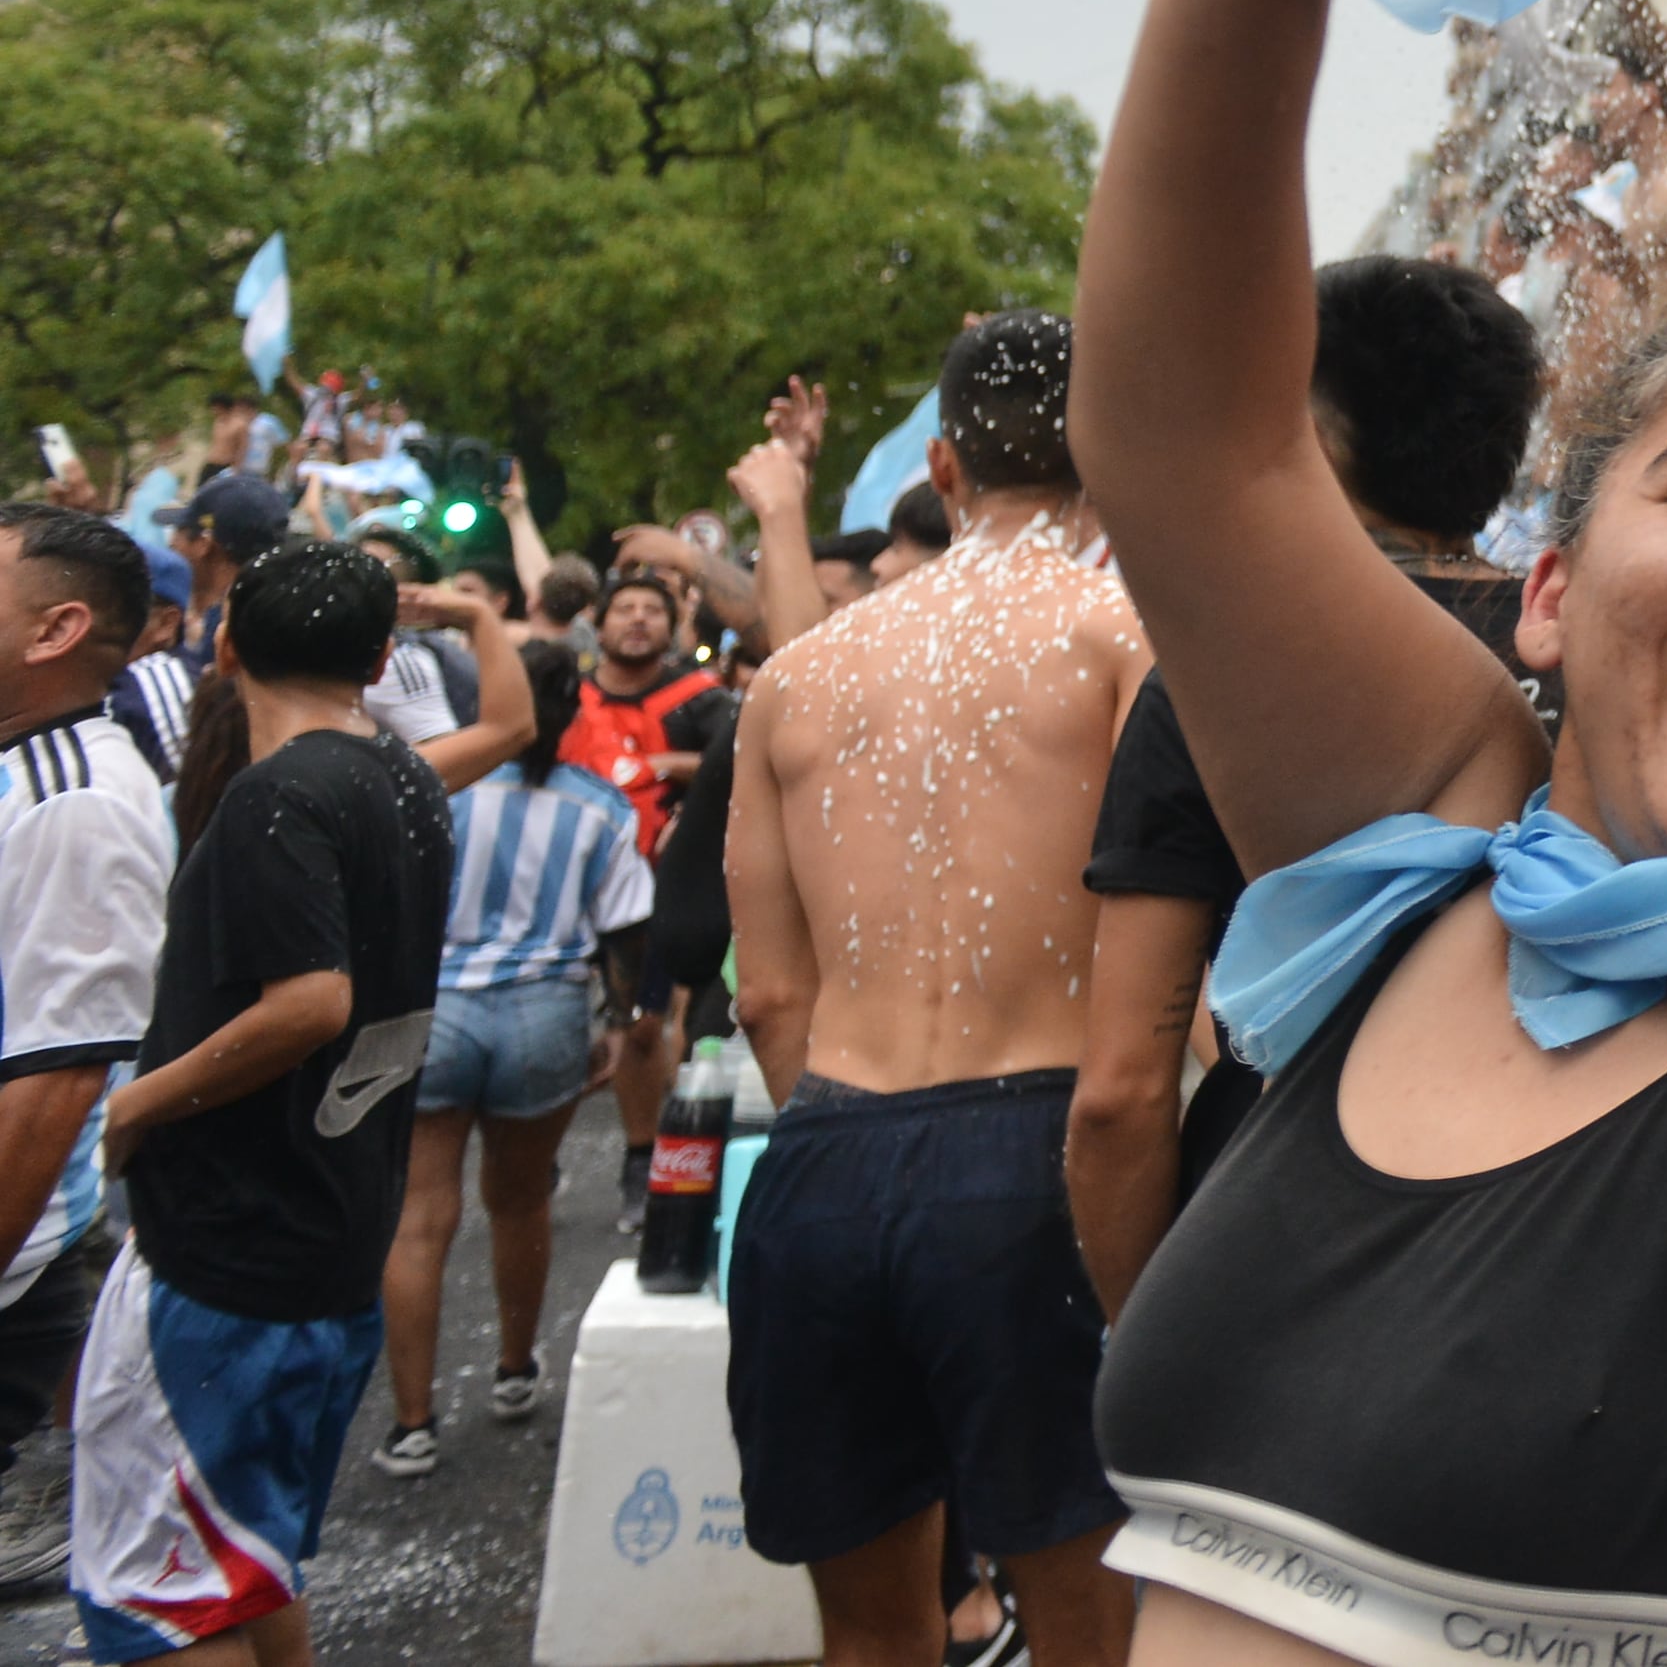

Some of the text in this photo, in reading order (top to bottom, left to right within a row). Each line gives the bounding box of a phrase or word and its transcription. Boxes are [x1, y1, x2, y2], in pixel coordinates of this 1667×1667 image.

[697, 1522, 746, 1550] Arg
[1171, 1512, 1363, 1614] Calvin Klein
[1442, 1610, 1597, 1667] Calvin
